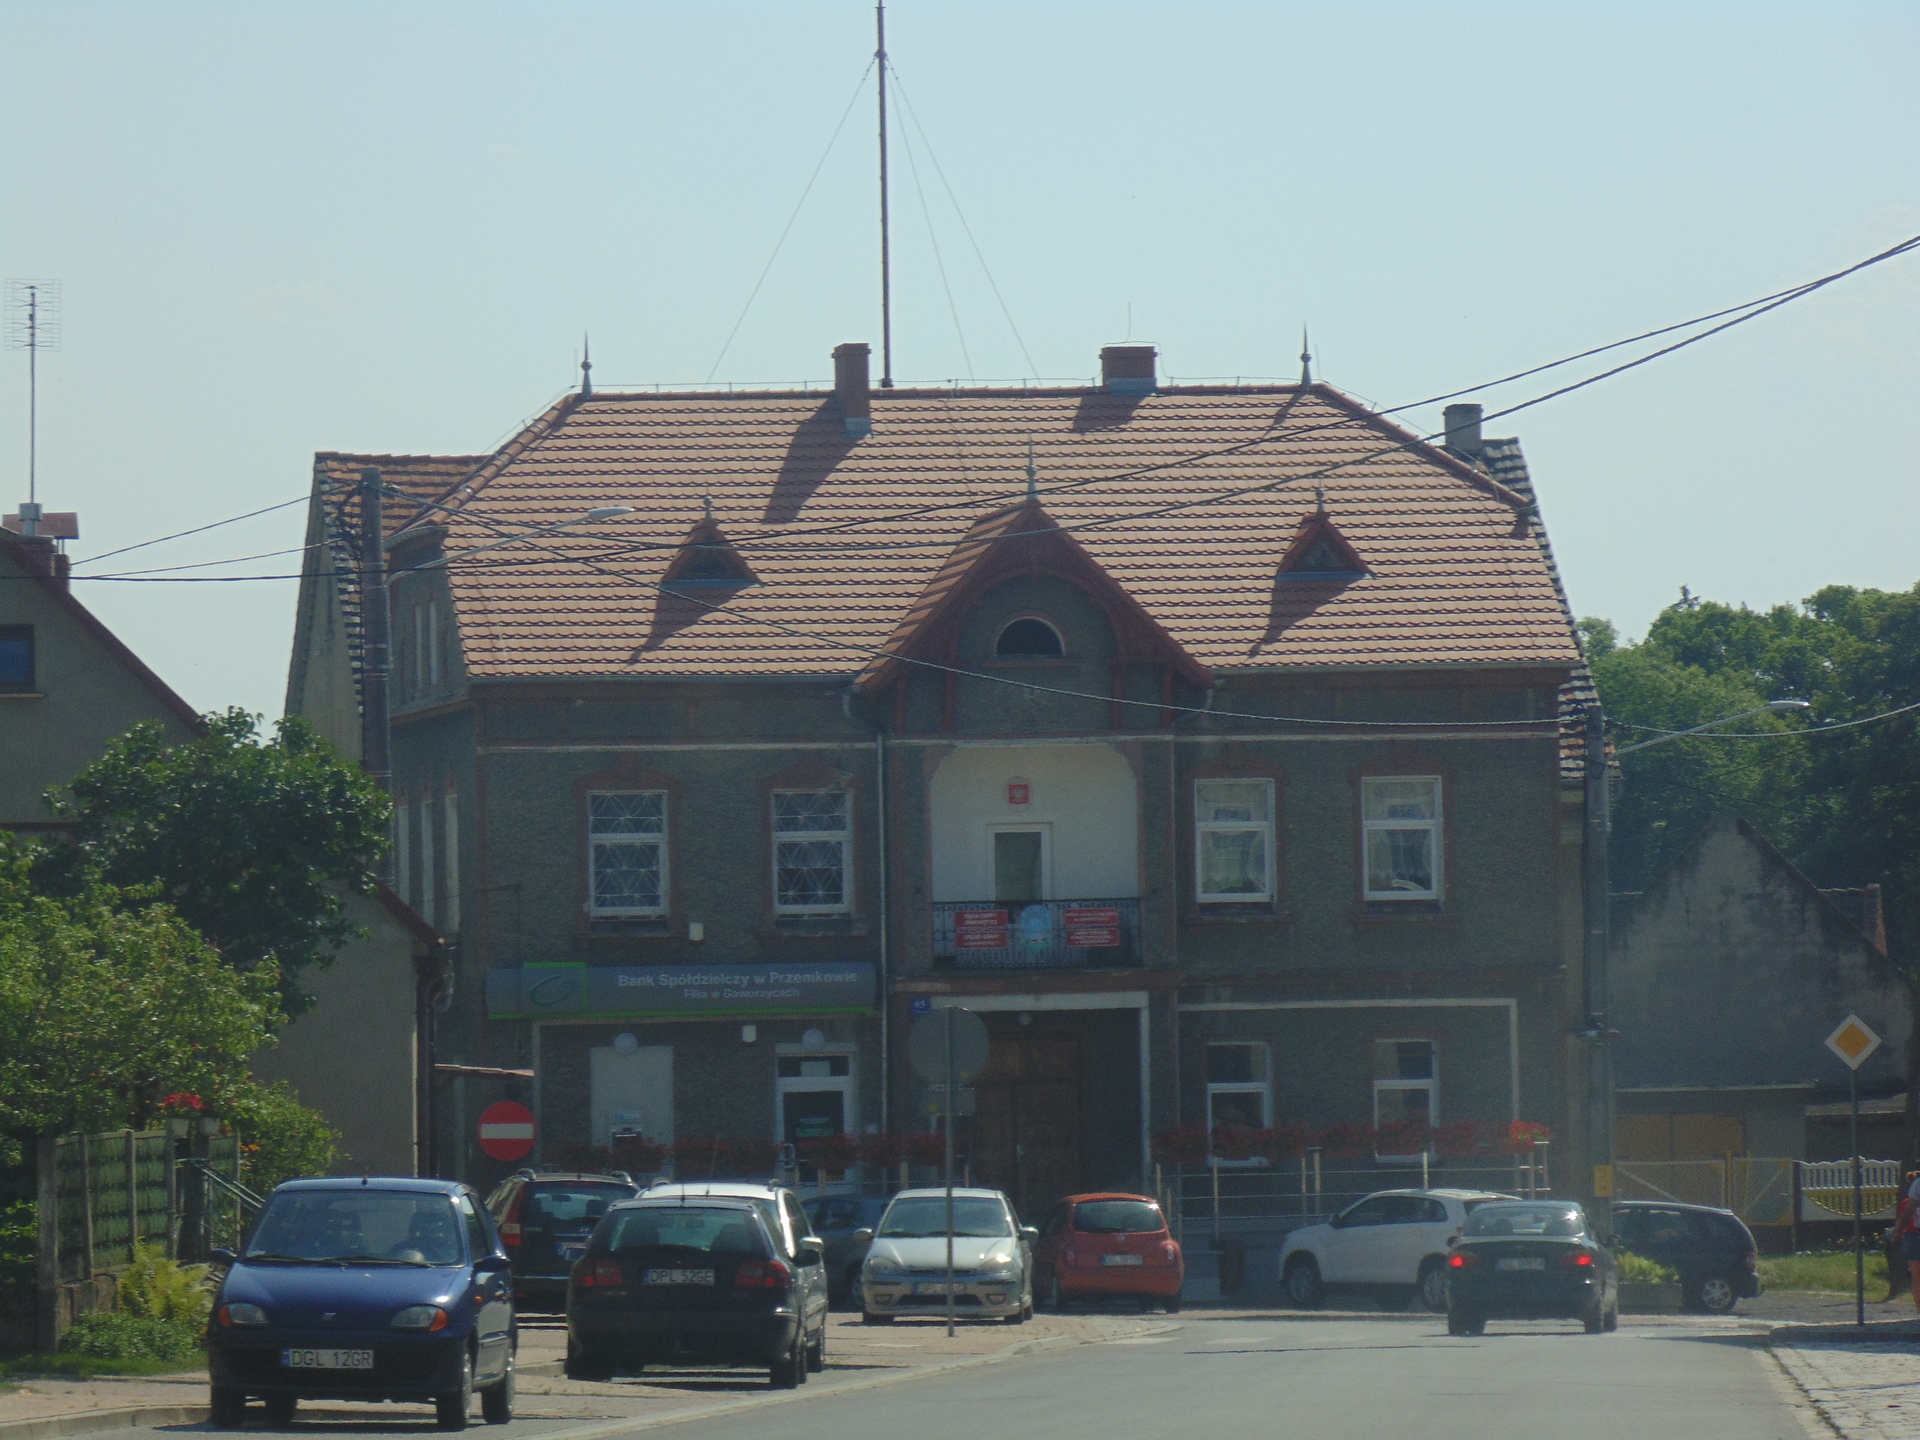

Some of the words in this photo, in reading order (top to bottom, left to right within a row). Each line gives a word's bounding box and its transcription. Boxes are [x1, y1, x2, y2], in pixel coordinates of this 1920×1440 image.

[618, 974, 655, 987] Bank
[754, 975, 766, 984] w
[769, 971, 858, 984] Przemkowie
[684, 988, 708, 999] Filia
[650, 1269, 677, 1283] DPL
[291, 1350, 326, 1367] DGL
[333, 1350, 372, 1367] 12GR
